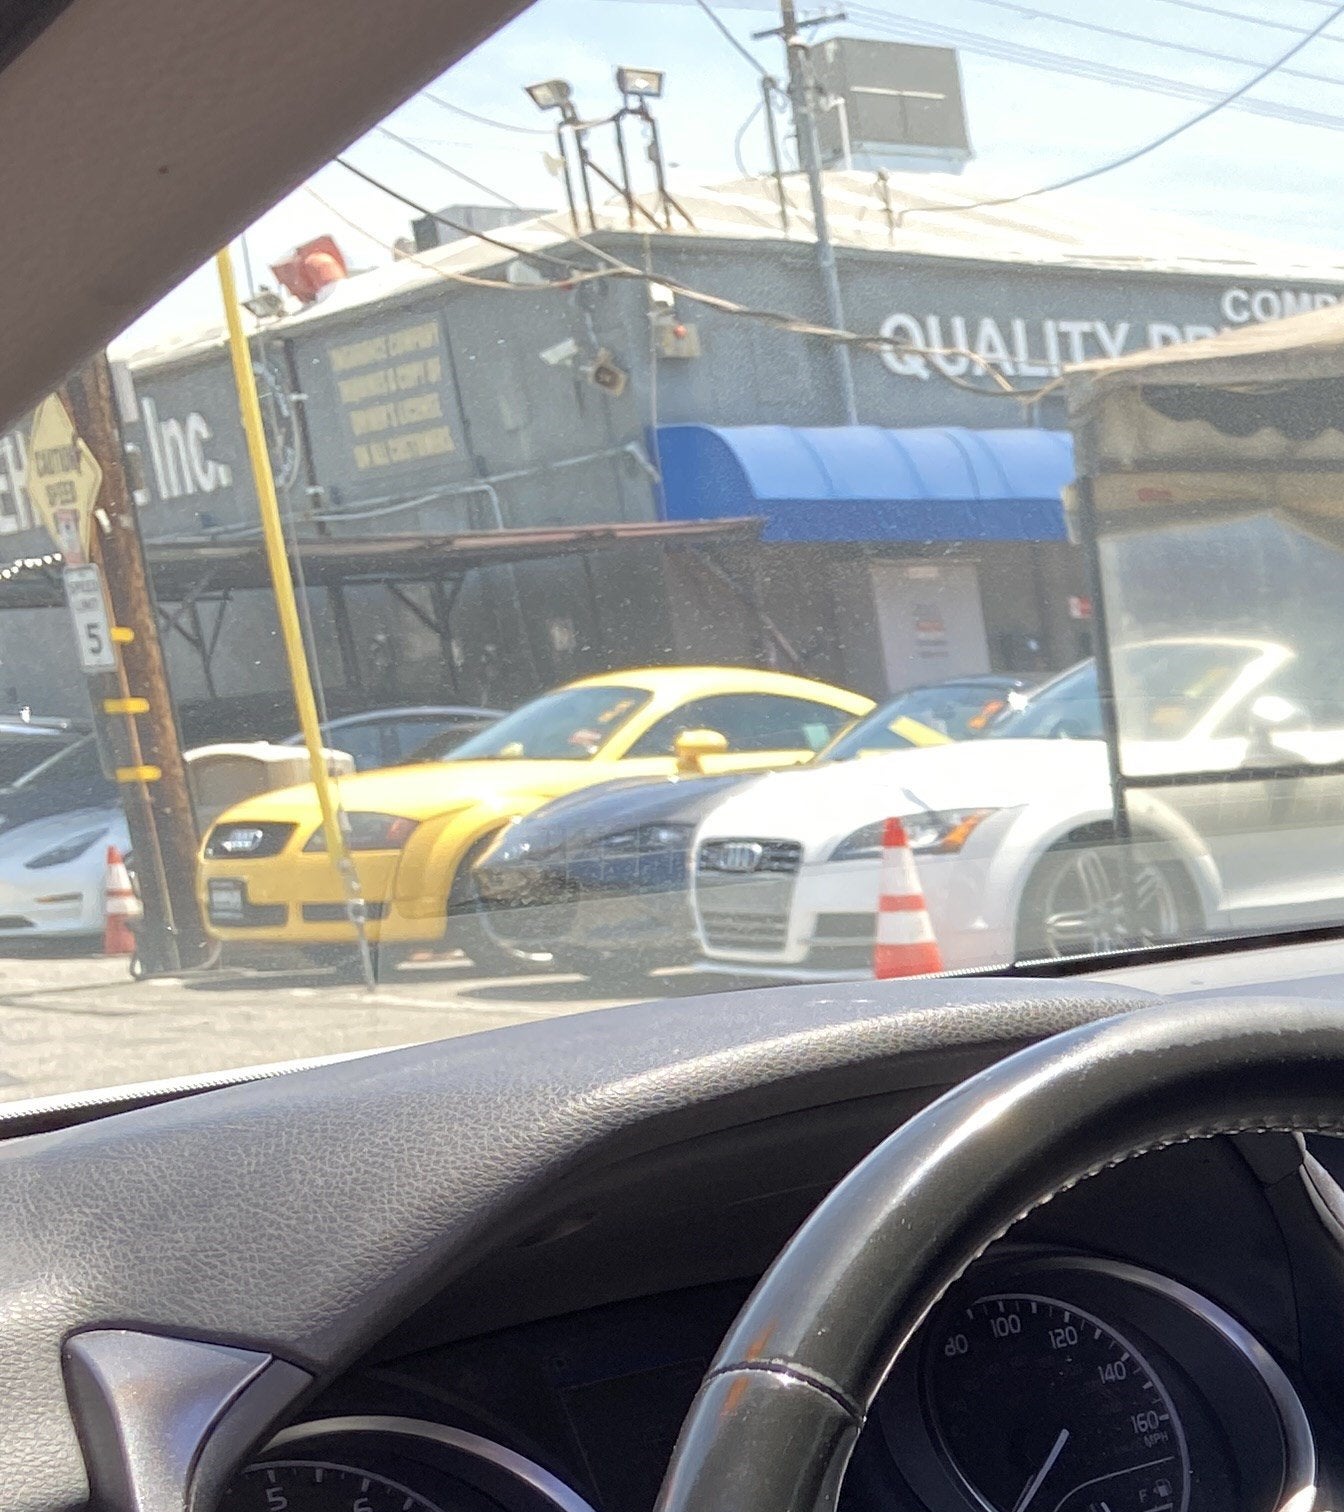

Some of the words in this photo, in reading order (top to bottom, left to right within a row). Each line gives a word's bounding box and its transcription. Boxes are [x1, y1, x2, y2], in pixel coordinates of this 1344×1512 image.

[878, 314, 1131, 381] QUALITY
[142, 397, 232, 501] Inc.
[87, 623, 102, 655] 5
[991, 1314, 1021, 1338] 100
[1049, 1326, 1078, 1349] 120
[944, 1333, 968, 1357] 80
[1098, 1361, 1126, 1385] 140
[1131, 1411, 1159, 1434] 160
[1144, 1431, 1168, 1448] MPH
[266, 1487, 288, 1512] 5
[1138, 1489, 1147, 1502] F
